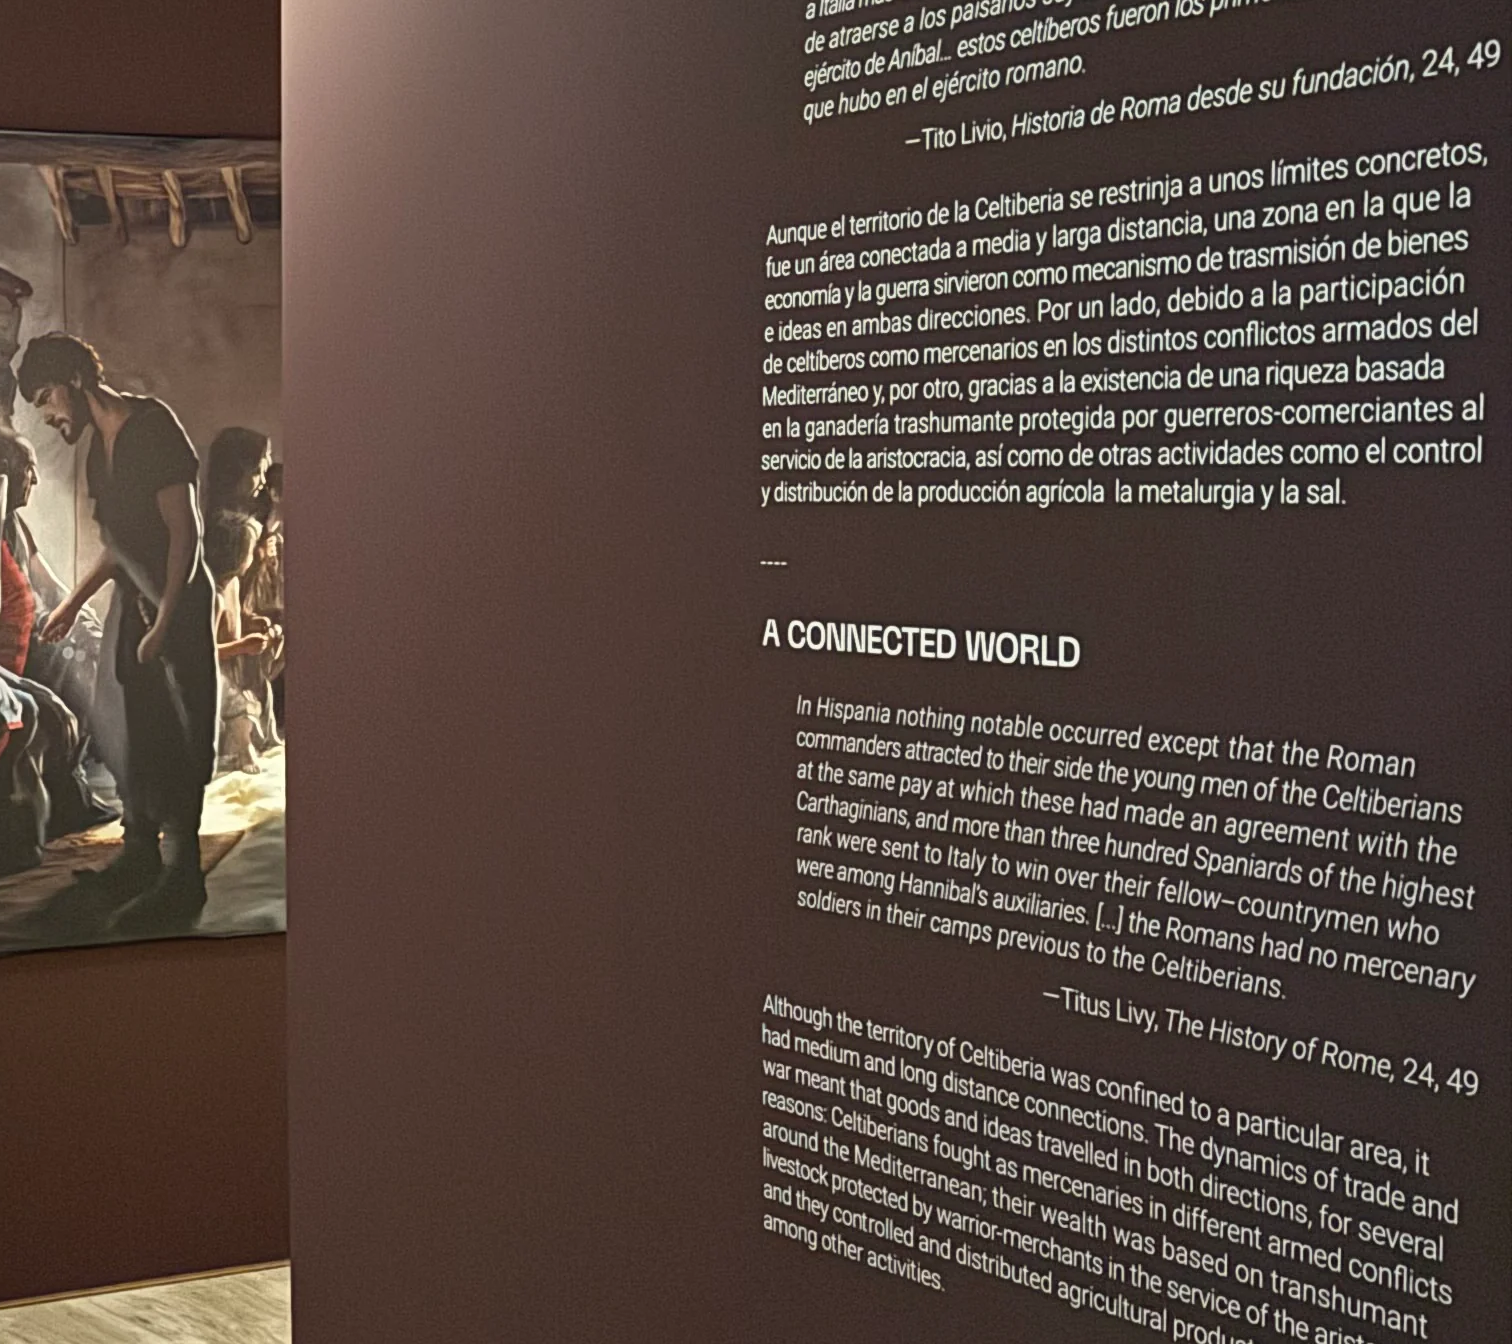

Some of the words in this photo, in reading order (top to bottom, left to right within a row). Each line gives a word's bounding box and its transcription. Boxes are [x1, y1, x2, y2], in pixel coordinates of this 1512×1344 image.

[961, 118, 1007, 145] Livio,
[1011, 104, 1085, 137] Historia
[1090, 99, 1115, 126] de
[1119, 93, 1181, 121] Roma
[1186, 77, 1253, 111] desde
[1257, 77, 1286, 101] su
[1292, 54, 1415, 96] fundación,
[1422, 46, 1460, 77] 24,
[1466, 38, 1501, 69] 49
[764, 326, 774, 343] e
[778, 319, 822, 341] ideas
[826, 320, 847, 338] en
[851, 311, 912, 336] ambas
[917, 304, 1030, 331] direcciones.
[1037, 298, 1073, 322] Por
[1078, 299, 1103, 319] un
[1110, 290, 1160, 318] lado,
[1167, 283, 1244, 313] debido
[1250, 287, 1264, 307] a
[1272, 279, 1291, 306] la
[1299, 266, 1465, 311] participación
[760, 448, 822, 471] servicio
[824, 447, 845, 470] de
[848, 446, 863, 469] la
[866, 445, 970, 471] aristocracia,
[975, 442, 1003, 468] así
[1007, 448, 1064, 467] como
[1068, 441, 1094, 466] de
[1098, 443, 1152, 466] otras
[1157, 438, 1283, 465] actividades
[1289, 443, 1359, 464] como
[1365, 436, 1386, 464] el
[1392, 434, 1482, 464] control
[762, 421, 782, 439] en
[786, 416, 800, 438] la
[804, 412, 889, 443] ganadería
[893, 410, 1014, 435] trashumante
[1018, 403, 1115, 436] protegida
[1122, 408, 1158, 434] por
[1163, 396, 1453, 434] guerreros-comerciantes
[1461, 392, 1484, 421] al
[762, 618, 780, 647] A
[787, 619, 956, 659] CONNECTED
[965, 629, 1080, 668] WORLD
[796, 694, 812, 715] In
[816, 696, 891, 724] Hispania
[895, 705, 965, 737] nothing
[970, 713, 1044, 739] notable
[1049, 723, 1142, 749] occurred
[1147, 732, 1220, 761] except
[1228, 734, 1275, 763] that
[1281, 739, 1319, 768] the
[1326, 744, 1415, 778] Roman
[1116, 997, 1158, 1033] Livy,
[1165, 1007, 1204, 1038] The
[1208, 1017, 1288, 1061] History
[1292, 1036, 1319, 1062] of
[1321, 1040, 1394, 1083] Rome,
[1403, 1057, 1439, 1093] 24,
[1446, 1067, 1479, 1096] 49
[763, 1213, 818, 1251] among
[821, 1233, 864, 1262] other
[866, 1250, 945, 1291] activities.
